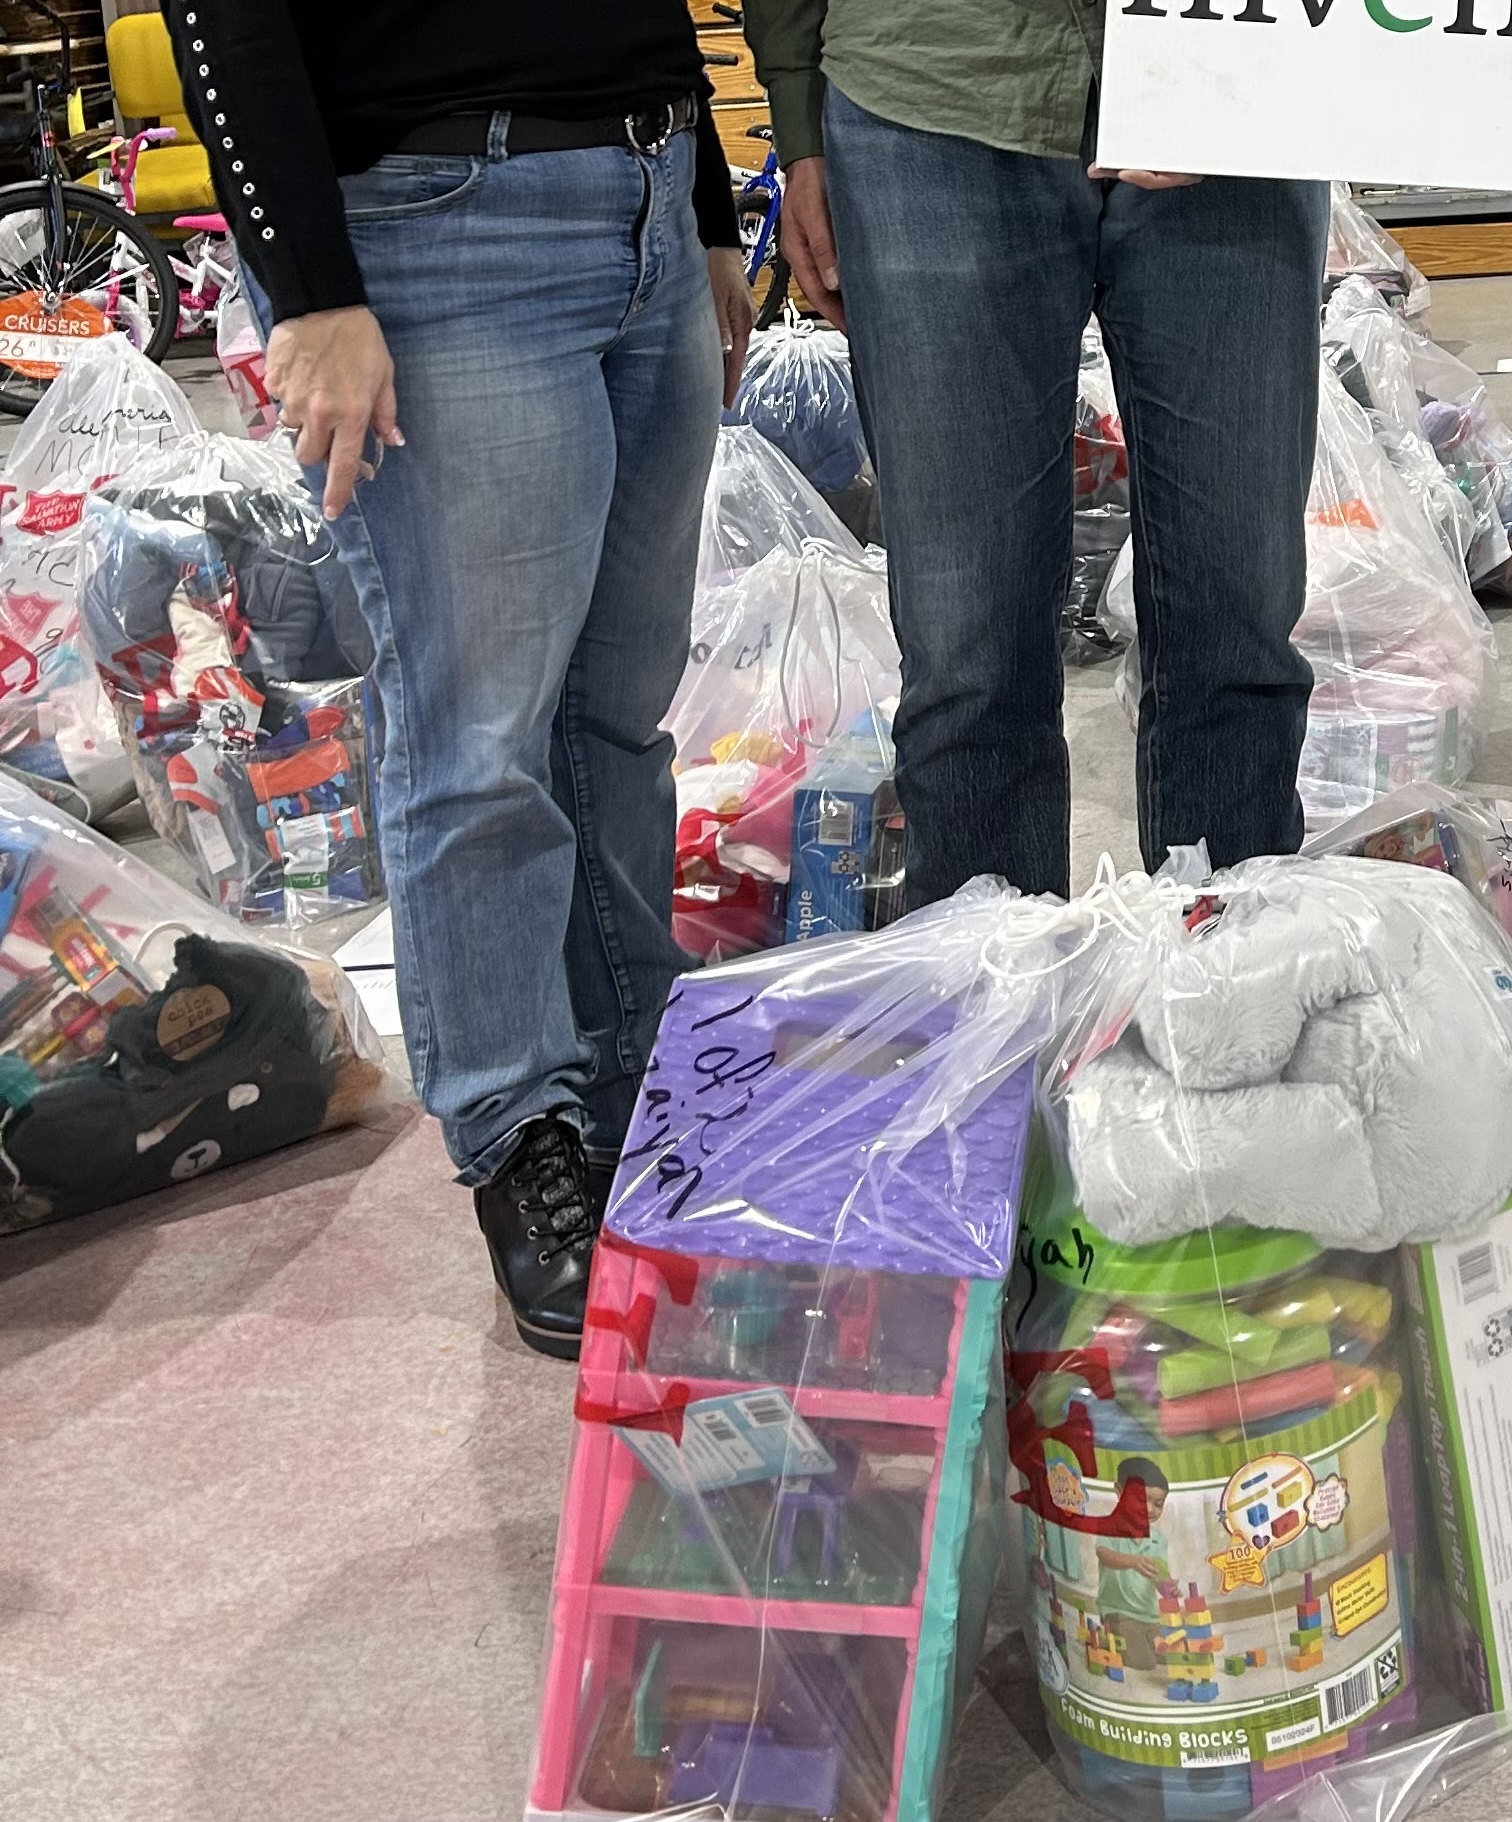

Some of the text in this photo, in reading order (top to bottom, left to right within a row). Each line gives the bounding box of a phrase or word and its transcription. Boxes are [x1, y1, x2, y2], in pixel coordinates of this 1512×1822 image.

[4, 314, 90, 335] CRUISERS
[37, 514, 75, 529] ARMY
[796, 889, 813, 942] Apple
[1412, 1325, 1438, 1401] Touch
[1229, 1546, 1251, 1560] 100
